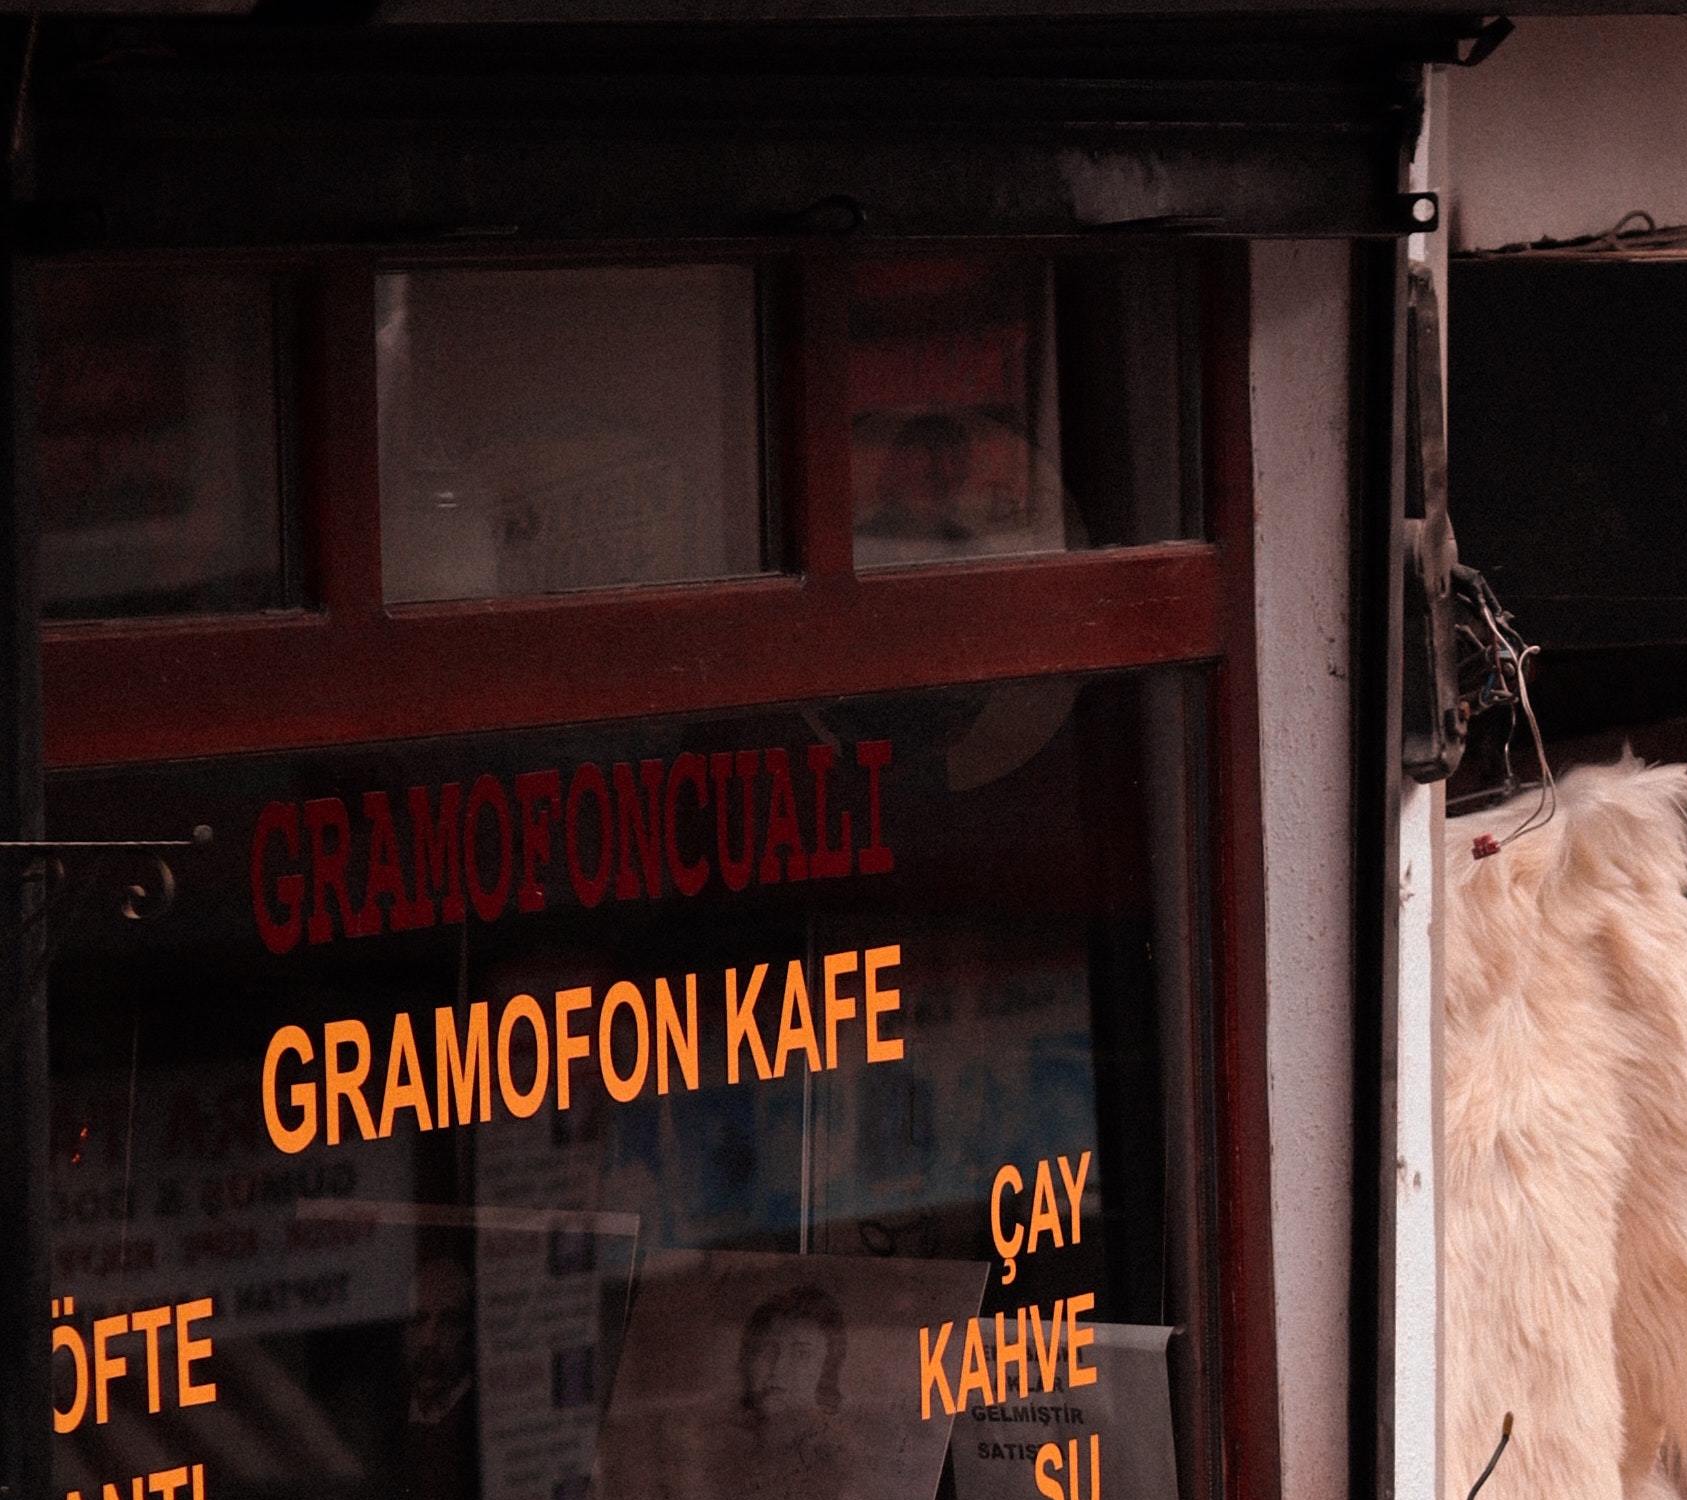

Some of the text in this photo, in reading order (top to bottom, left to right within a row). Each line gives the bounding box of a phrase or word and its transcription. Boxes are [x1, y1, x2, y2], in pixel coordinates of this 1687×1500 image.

[262, 973, 698, 1154] GRAMOFON
[725, 944, 904, 1084] KAFE
[990, 1150, 1092, 1285] ÇAY
[918, 1291, 1097, 1420] KAHVE
[972, 1402, 1085, 1427] GELMİŞTİR
